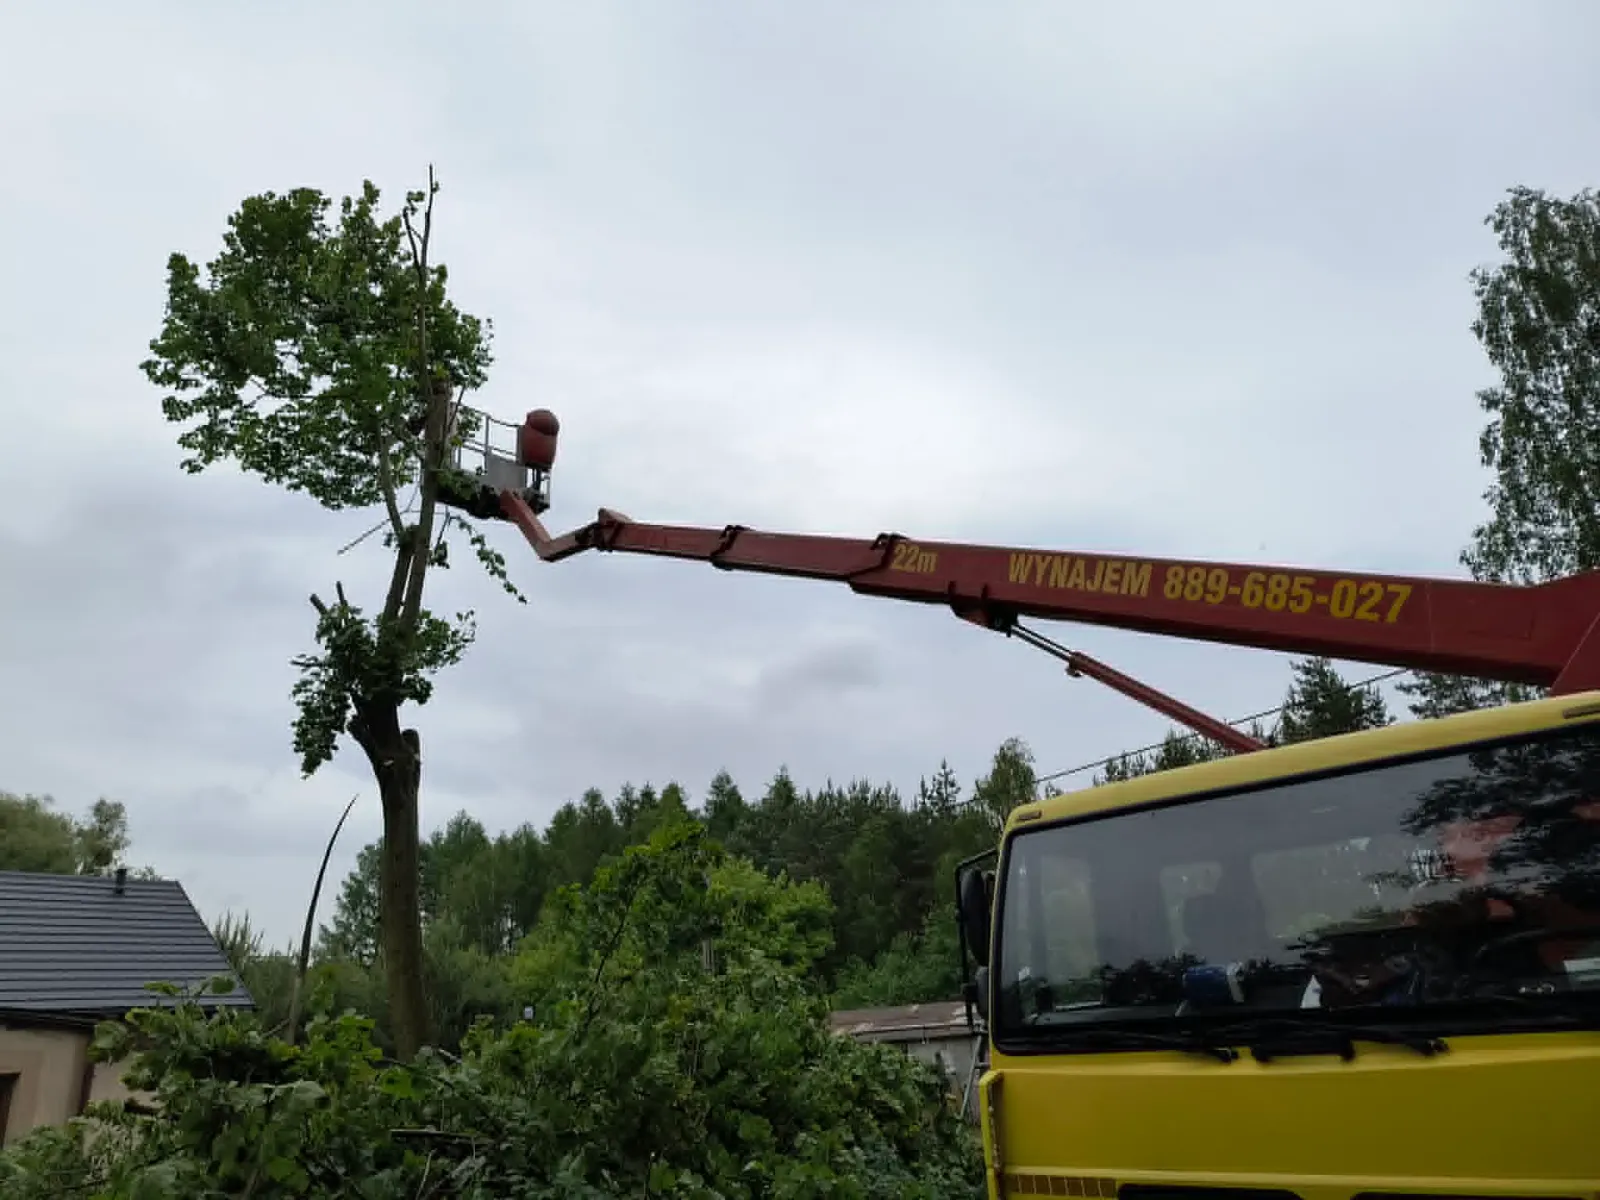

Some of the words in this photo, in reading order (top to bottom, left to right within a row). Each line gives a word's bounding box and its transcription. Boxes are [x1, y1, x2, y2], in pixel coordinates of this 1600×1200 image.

[891, 543, 938, 573] 22m
[1008, 552, 1153, 597] WYNAJEM
[1163, 565, 1412, 624] 889-685-027
